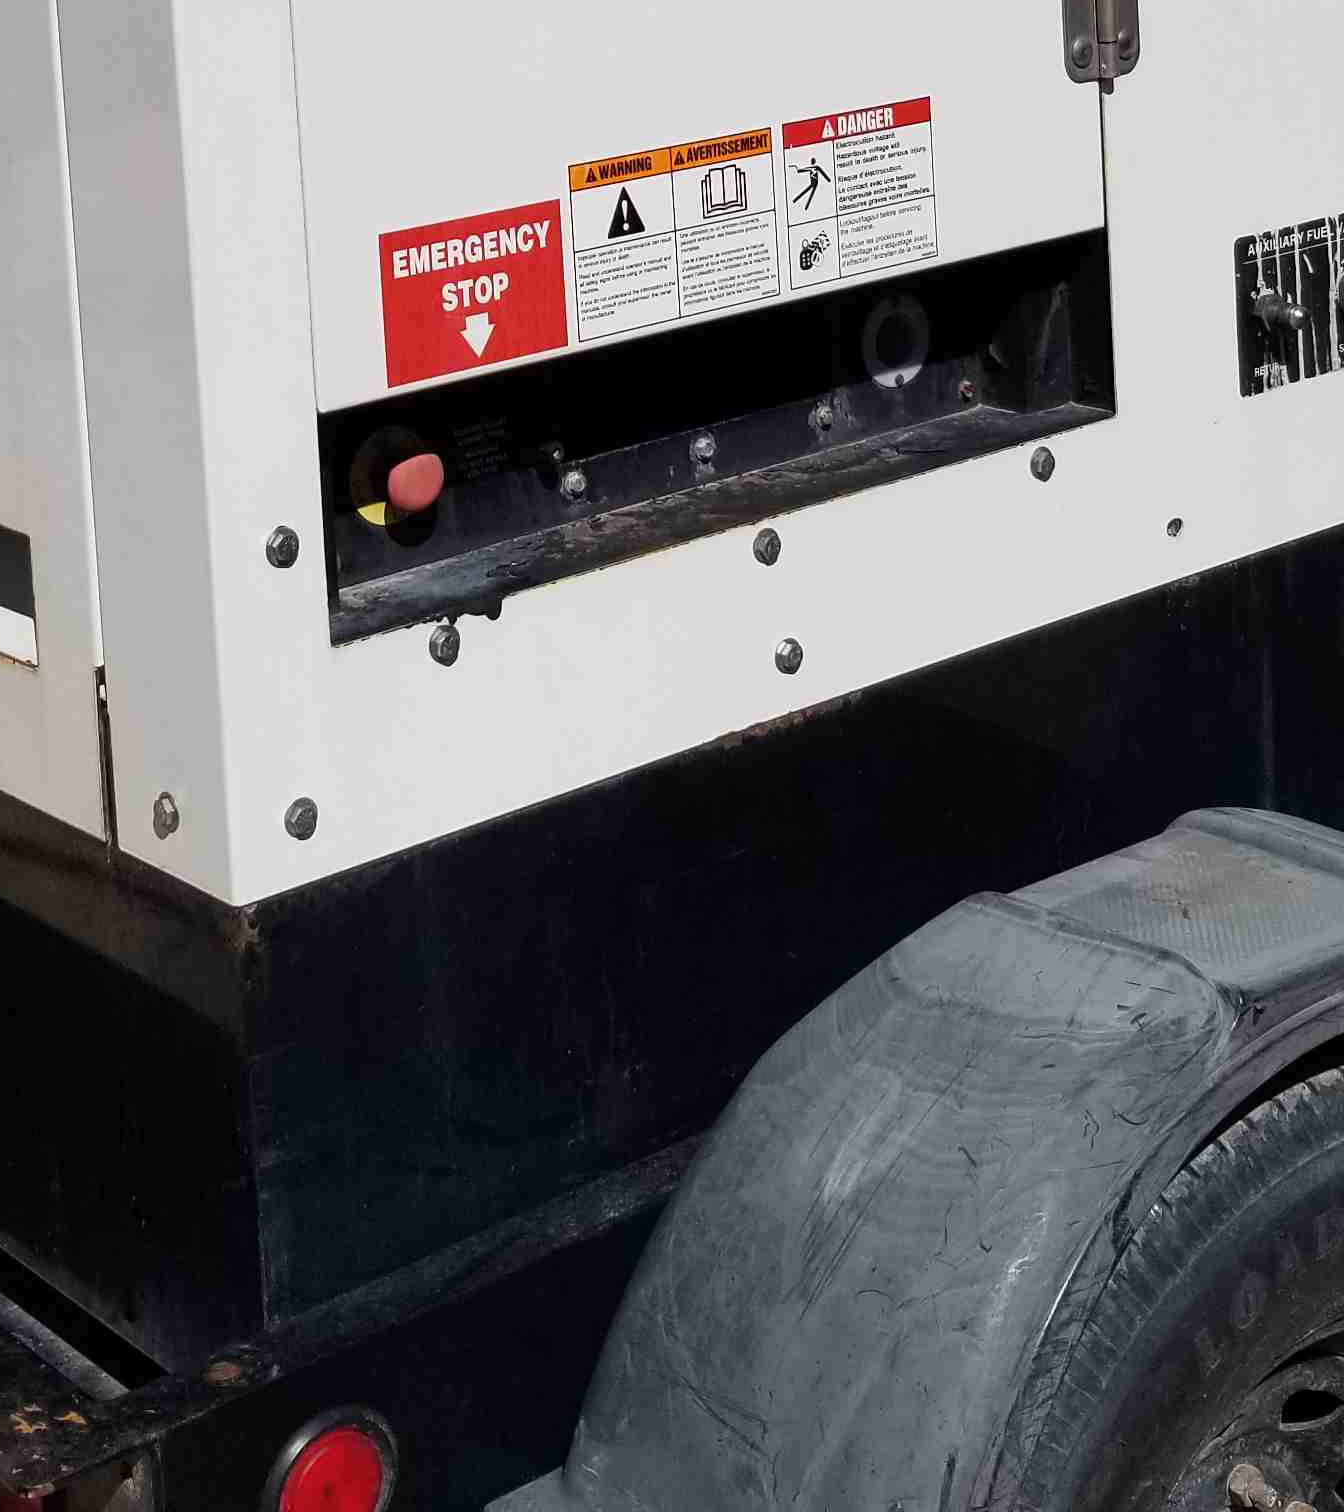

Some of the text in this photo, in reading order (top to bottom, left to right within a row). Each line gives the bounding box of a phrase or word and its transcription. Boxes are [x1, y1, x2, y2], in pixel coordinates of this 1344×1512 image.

[837, 107, 894, 136] DANGER
[687, 134, 769, 163] AVERTISSEMENT
[598, 157, 652, 180] WARNING
[392, 220, 552, 279] EMERGENCY
[441, 274, 510, 313] STOP
